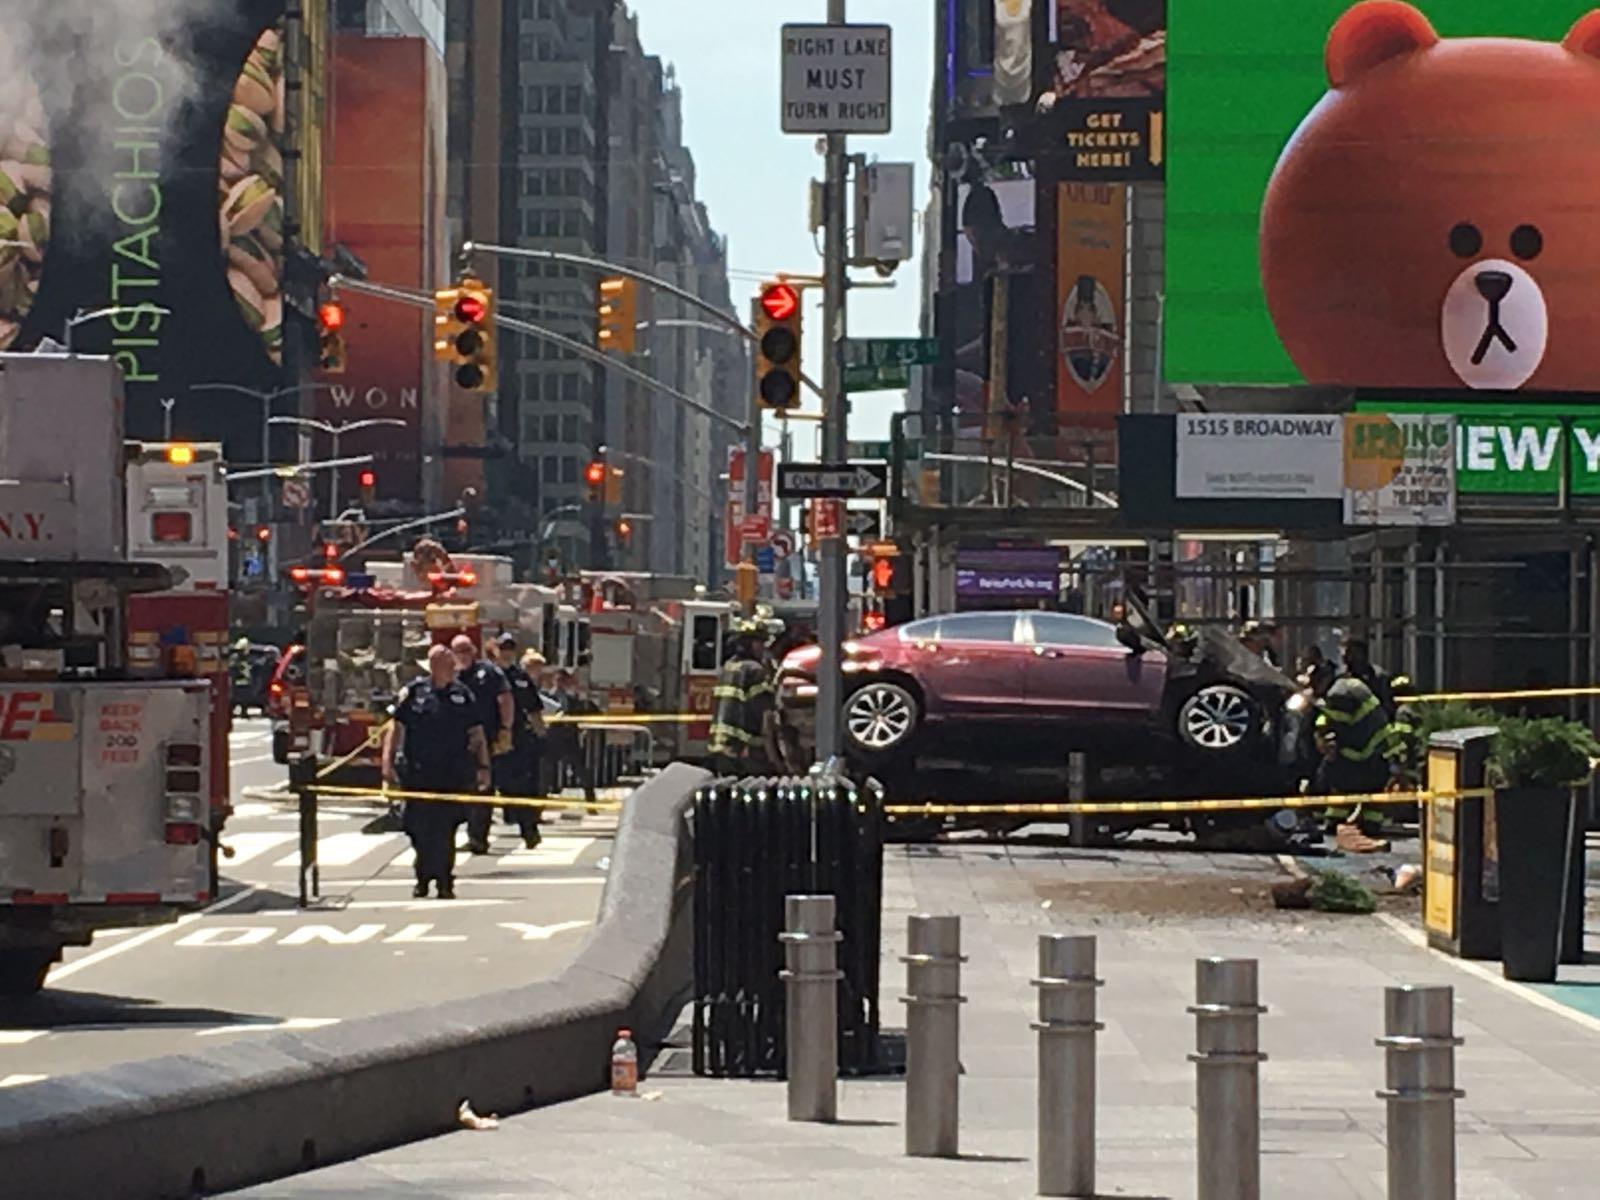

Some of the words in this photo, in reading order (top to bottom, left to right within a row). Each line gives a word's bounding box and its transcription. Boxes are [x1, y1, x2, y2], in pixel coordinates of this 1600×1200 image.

[786, 39, 834, 56] RIGHT
[844, 39, 888, 56] LANE
[807, 68, 865, 90] MUST
[786, 102, 828, 119] TURN
[838, 102, 886, 119] RIGHT
[1086, 113, 1122, 128] GET
[1067, 132, 1141, 147] TICKETS
[111, 37, 162, 383] PISTACHIOS
[330, 386, 418, 408] WON
[1187, 419, 1229, 436] 1515
[1233, 419, 1335, 437] BROADWAY
[1456, 425, 1562, 471] EW
[792, 474, 823, 489] ONE
[101, 703, 142, 716] KEEP
[100, 718, 142, 732] BACK
[106, 734, 138, 748] 200
